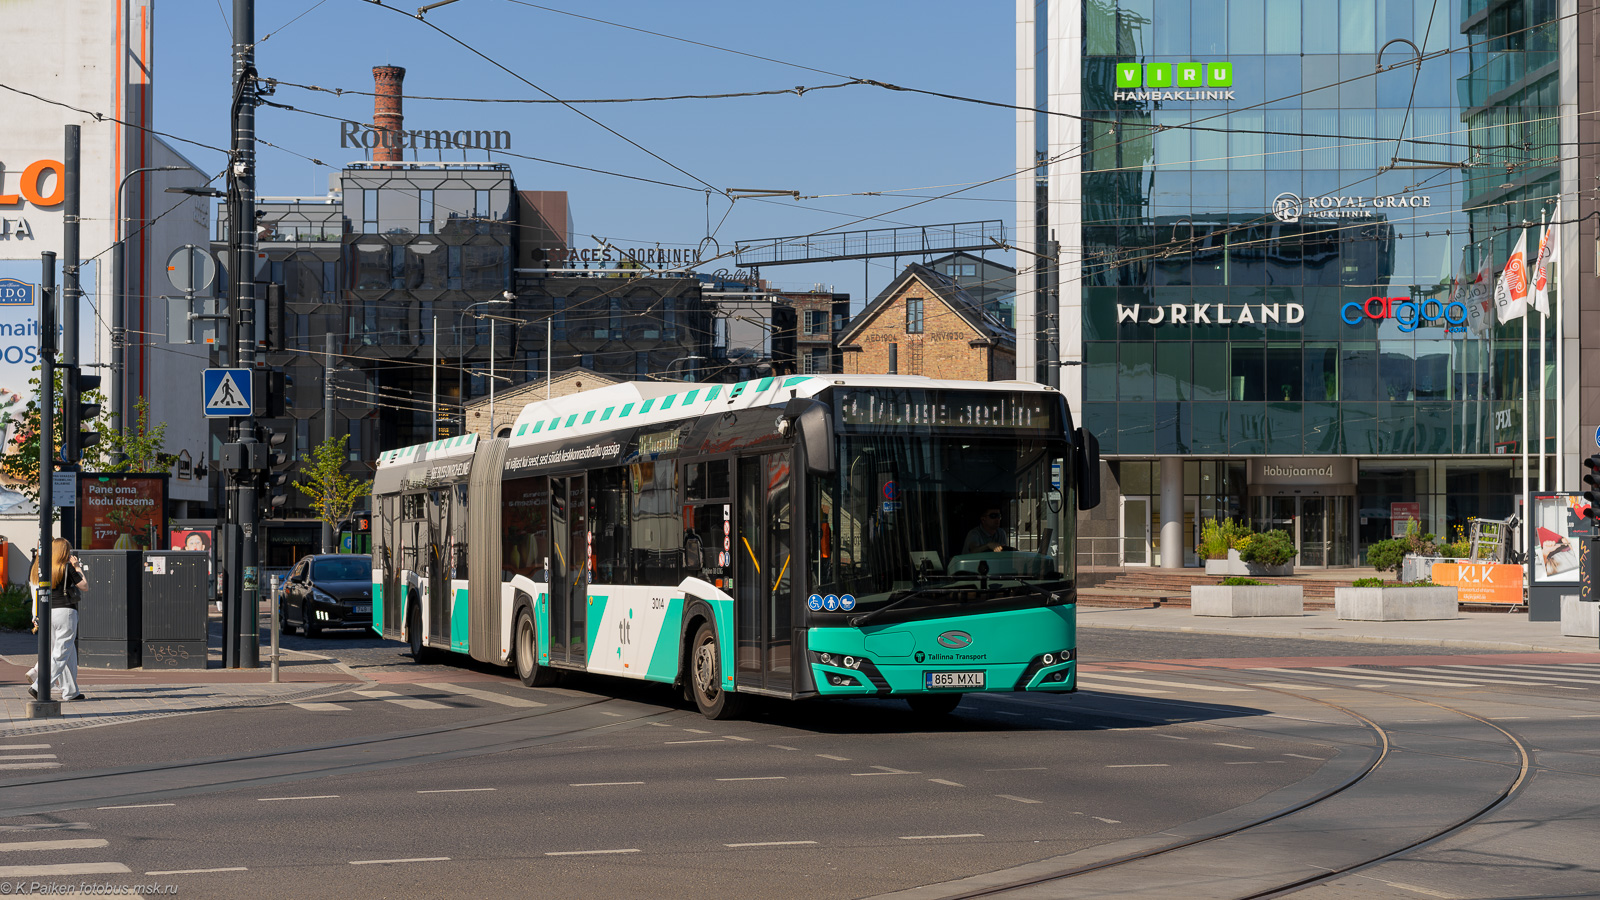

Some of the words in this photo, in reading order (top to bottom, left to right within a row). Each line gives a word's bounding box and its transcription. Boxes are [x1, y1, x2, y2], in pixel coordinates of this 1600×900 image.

[1123, 68, 1226, 81] VIRU
[1113, 90, 1236, 101] HAMBAKLIINIK
[340, 121, 512, 150] Rotermann
[1308, 196, 1367, 208] ROYAL
[1373, 195, 1431, 208] GRACE
[1116, 302, 1305, 324] WORKLAND
[89, 485, 113, 494] Pane
[115, 486, 137, 494] oma
[88, 497, 113, 506] kodu
[115, 496, 155, 506] õitsema
[360, 519, 369, 530] 18
[94, 530, 112, 539] 17.99
[1458, 565, 1495, 584] KLK
[651, 597, 665, 610] 3014
[955, 653, 987, 661] Transport
[934, 674, 954, 685] 865
[957, 673, 981, 684] MXL
